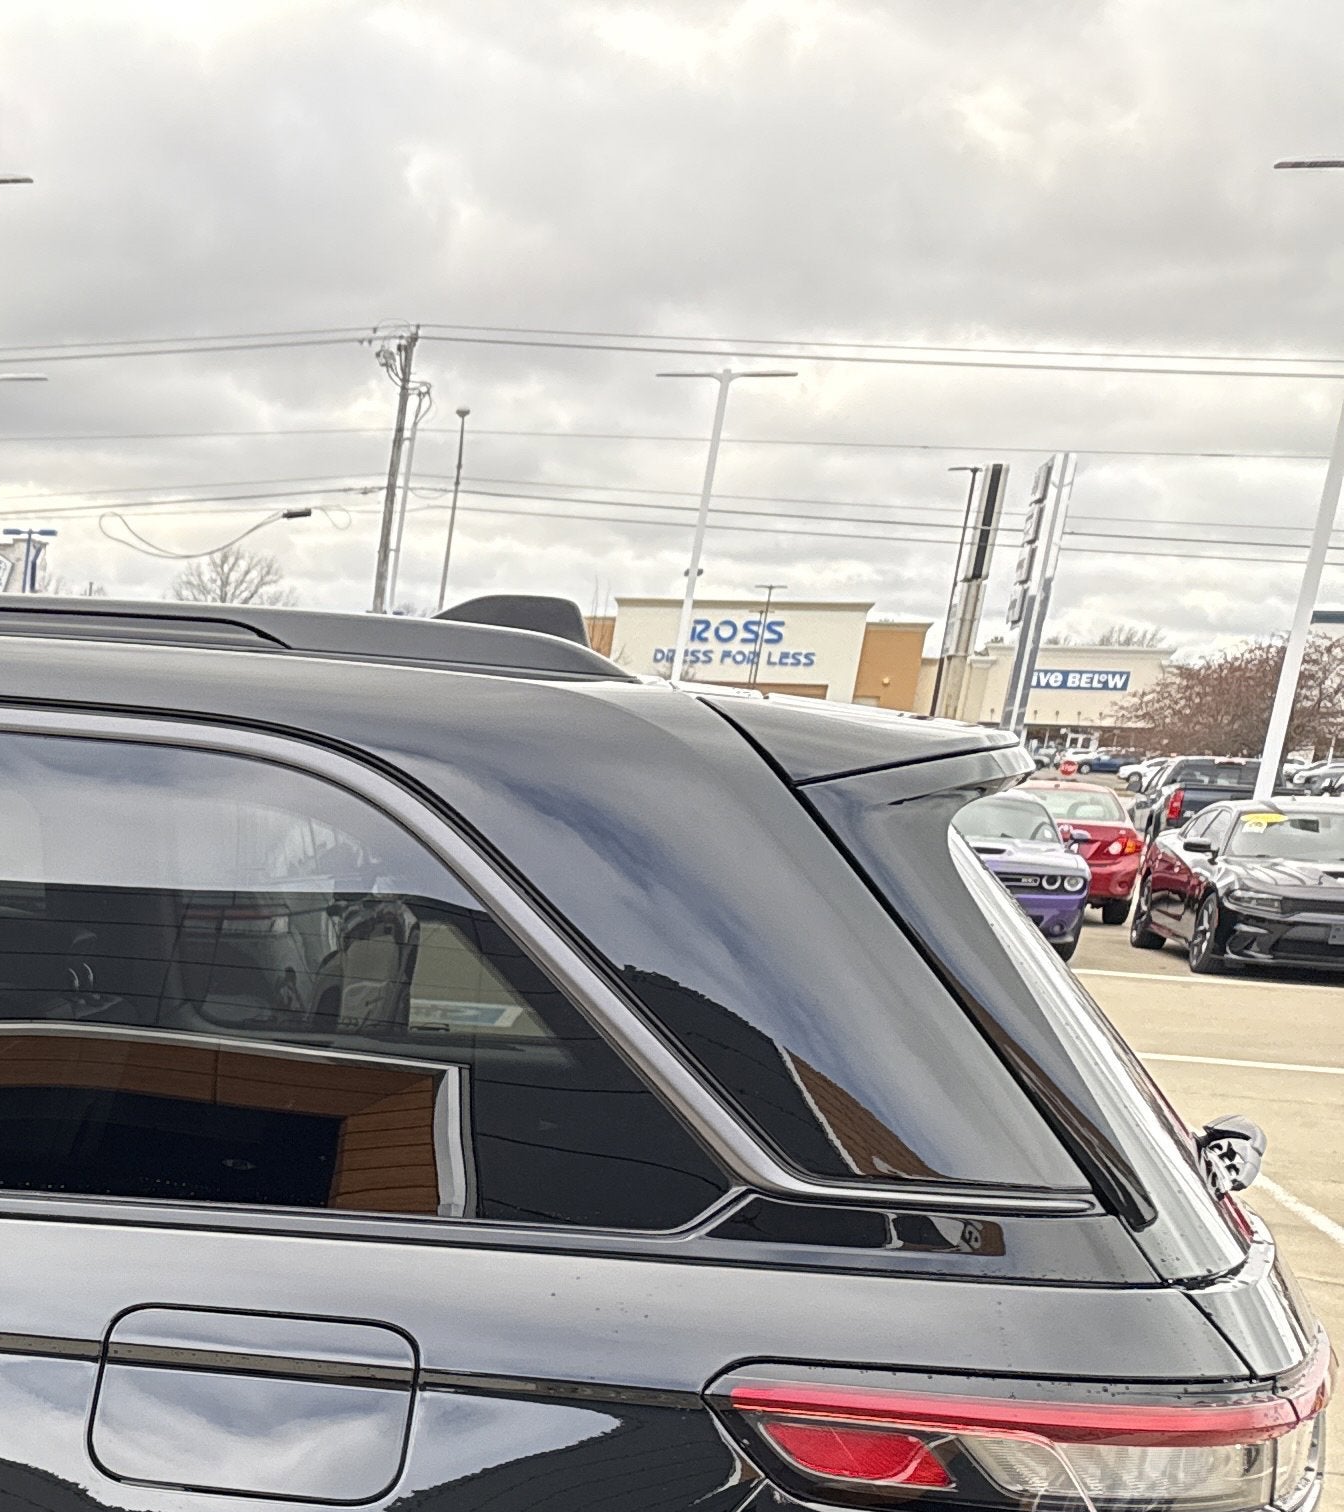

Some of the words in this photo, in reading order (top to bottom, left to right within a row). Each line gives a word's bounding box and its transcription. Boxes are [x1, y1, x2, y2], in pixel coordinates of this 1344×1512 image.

[690, 619, 785, 644] ROSS
[720, 651, 759, 665] FOR
[767, 651, 816, 667] LESS
[1031, 671, 1064, 687] ive
[1066, 672, 1128, 689] BELOW
